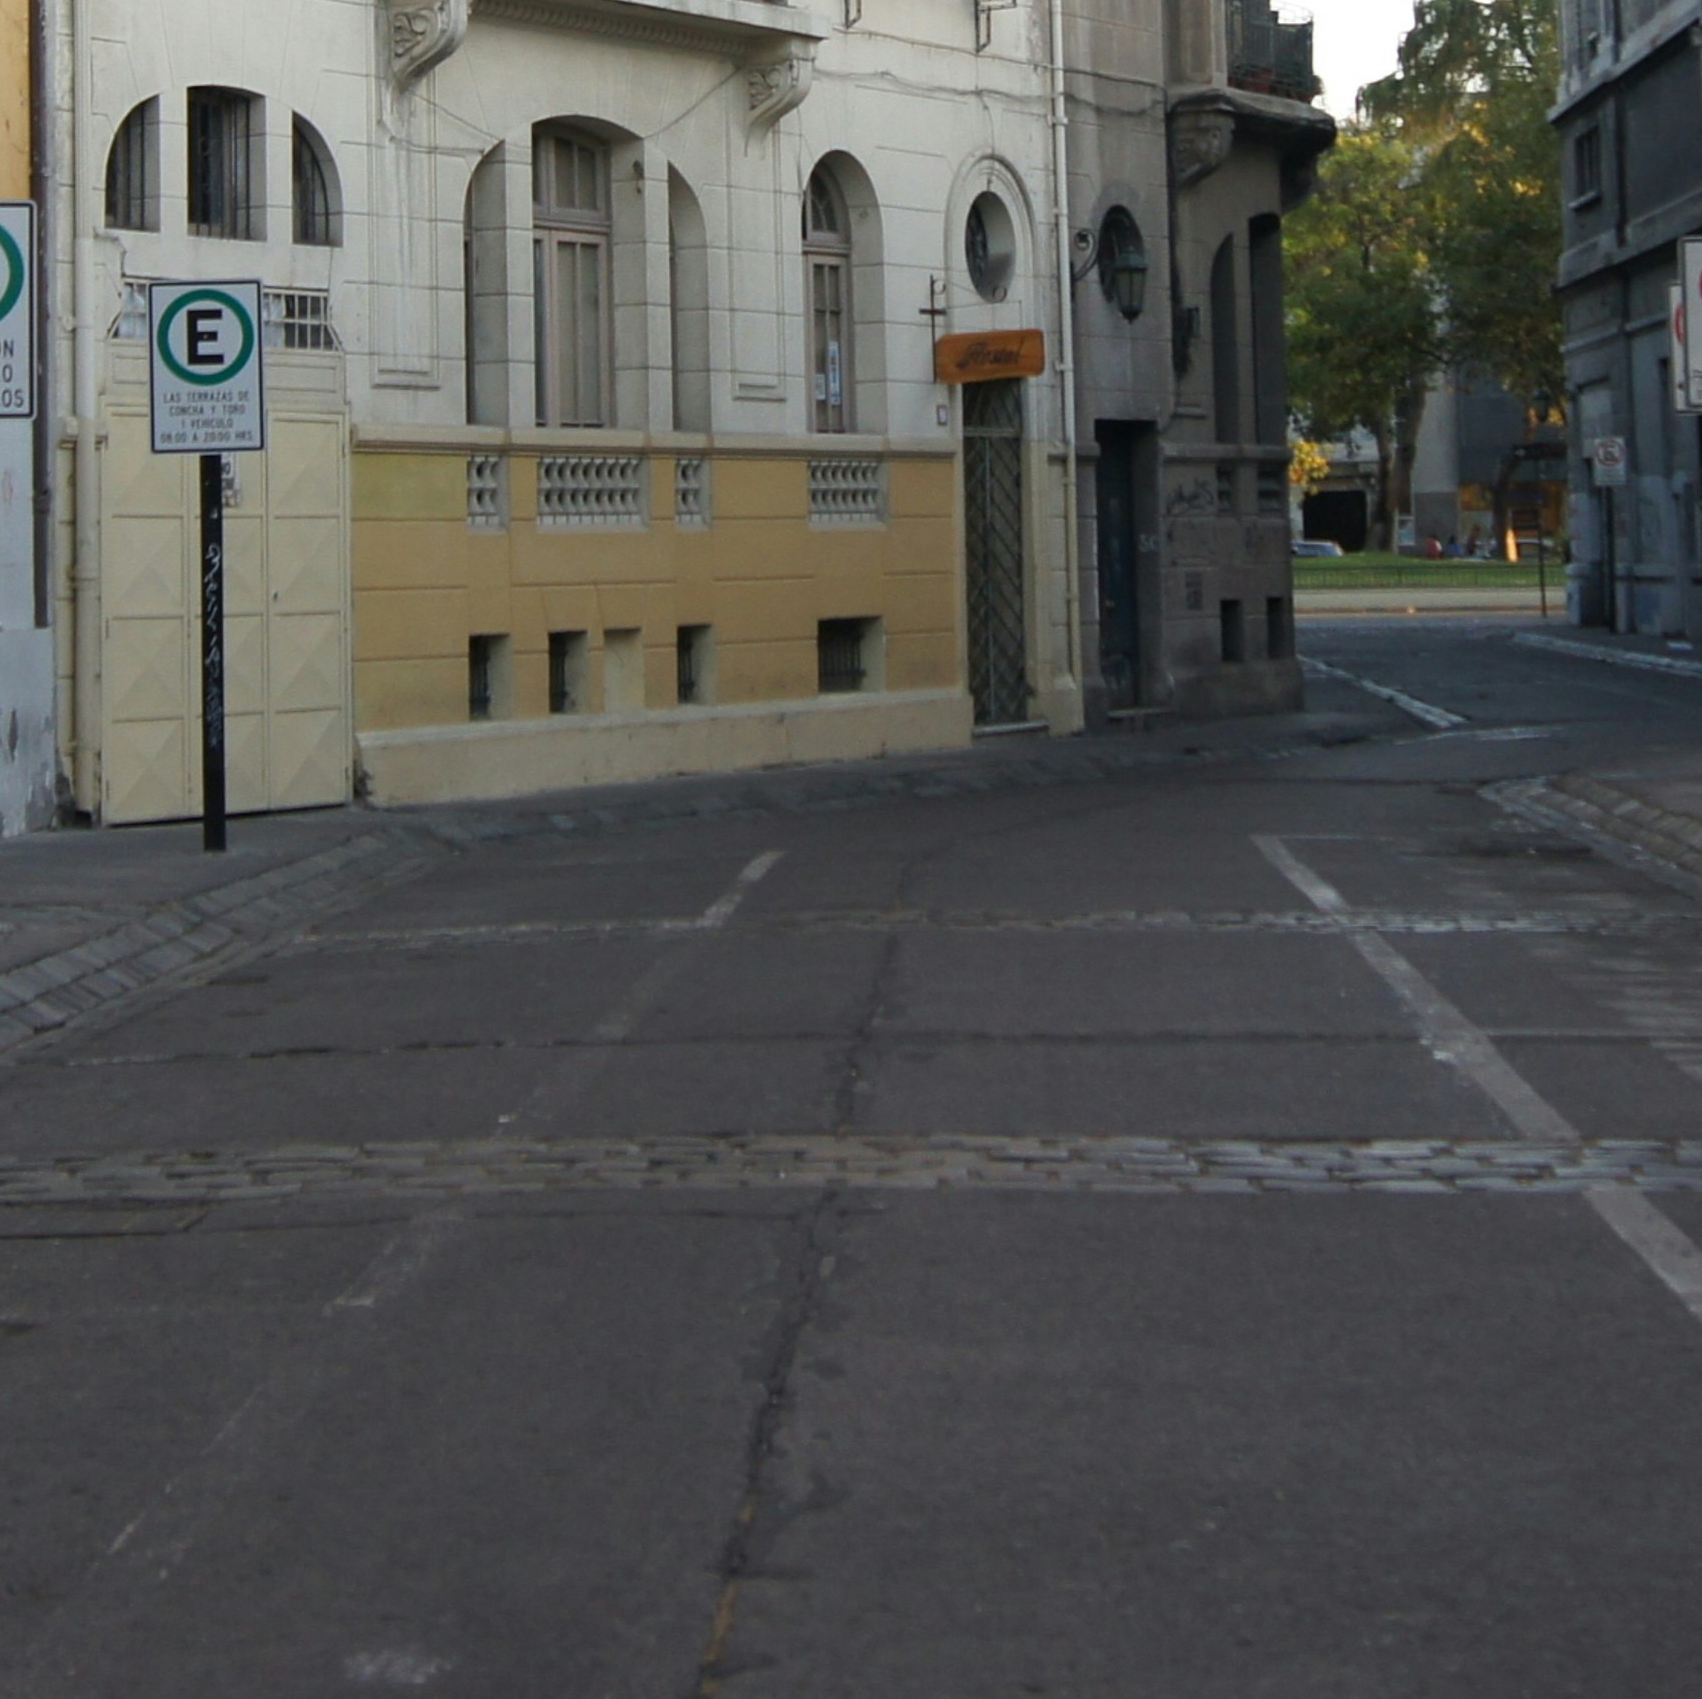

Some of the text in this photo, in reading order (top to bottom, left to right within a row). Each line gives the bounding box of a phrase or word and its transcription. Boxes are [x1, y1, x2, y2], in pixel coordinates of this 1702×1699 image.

[187, 309, 224, 365] E
[163, 390, 249, 404] LAS TERRAZAS DE
[169, 405, 204, 417] CONCHA
[223, 403, 246, 415] TORO
[191, 417, 234, 429] VEHICULO
